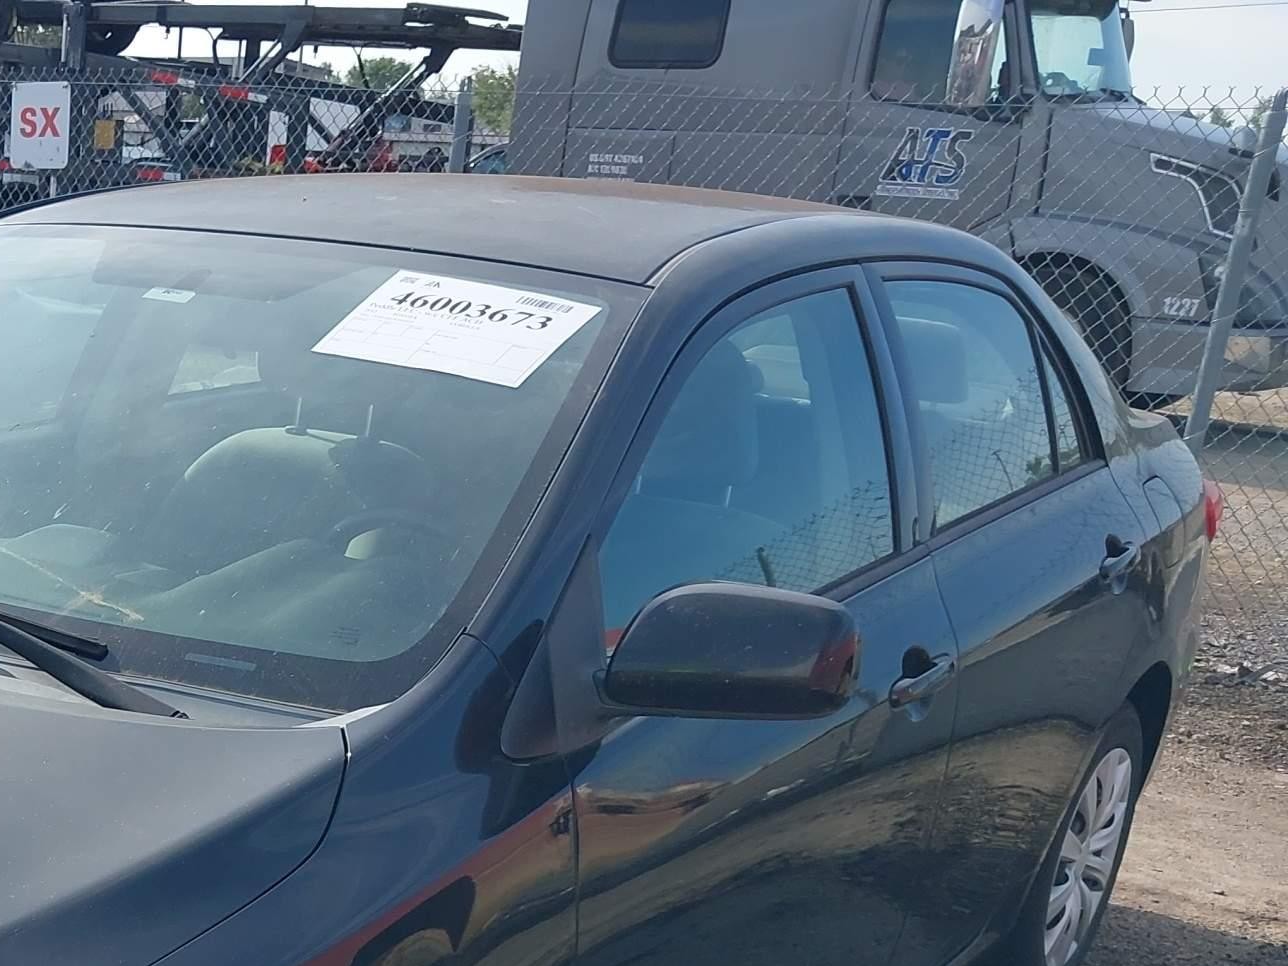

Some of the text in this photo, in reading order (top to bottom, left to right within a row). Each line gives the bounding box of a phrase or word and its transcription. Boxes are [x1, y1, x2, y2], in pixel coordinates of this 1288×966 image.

[20, 107, 61, 138] SX
[879, 126, 975, 185] ATS
[390, 291, 554, 331] 46003673
[1164, 296, 1200, 317] 1227
